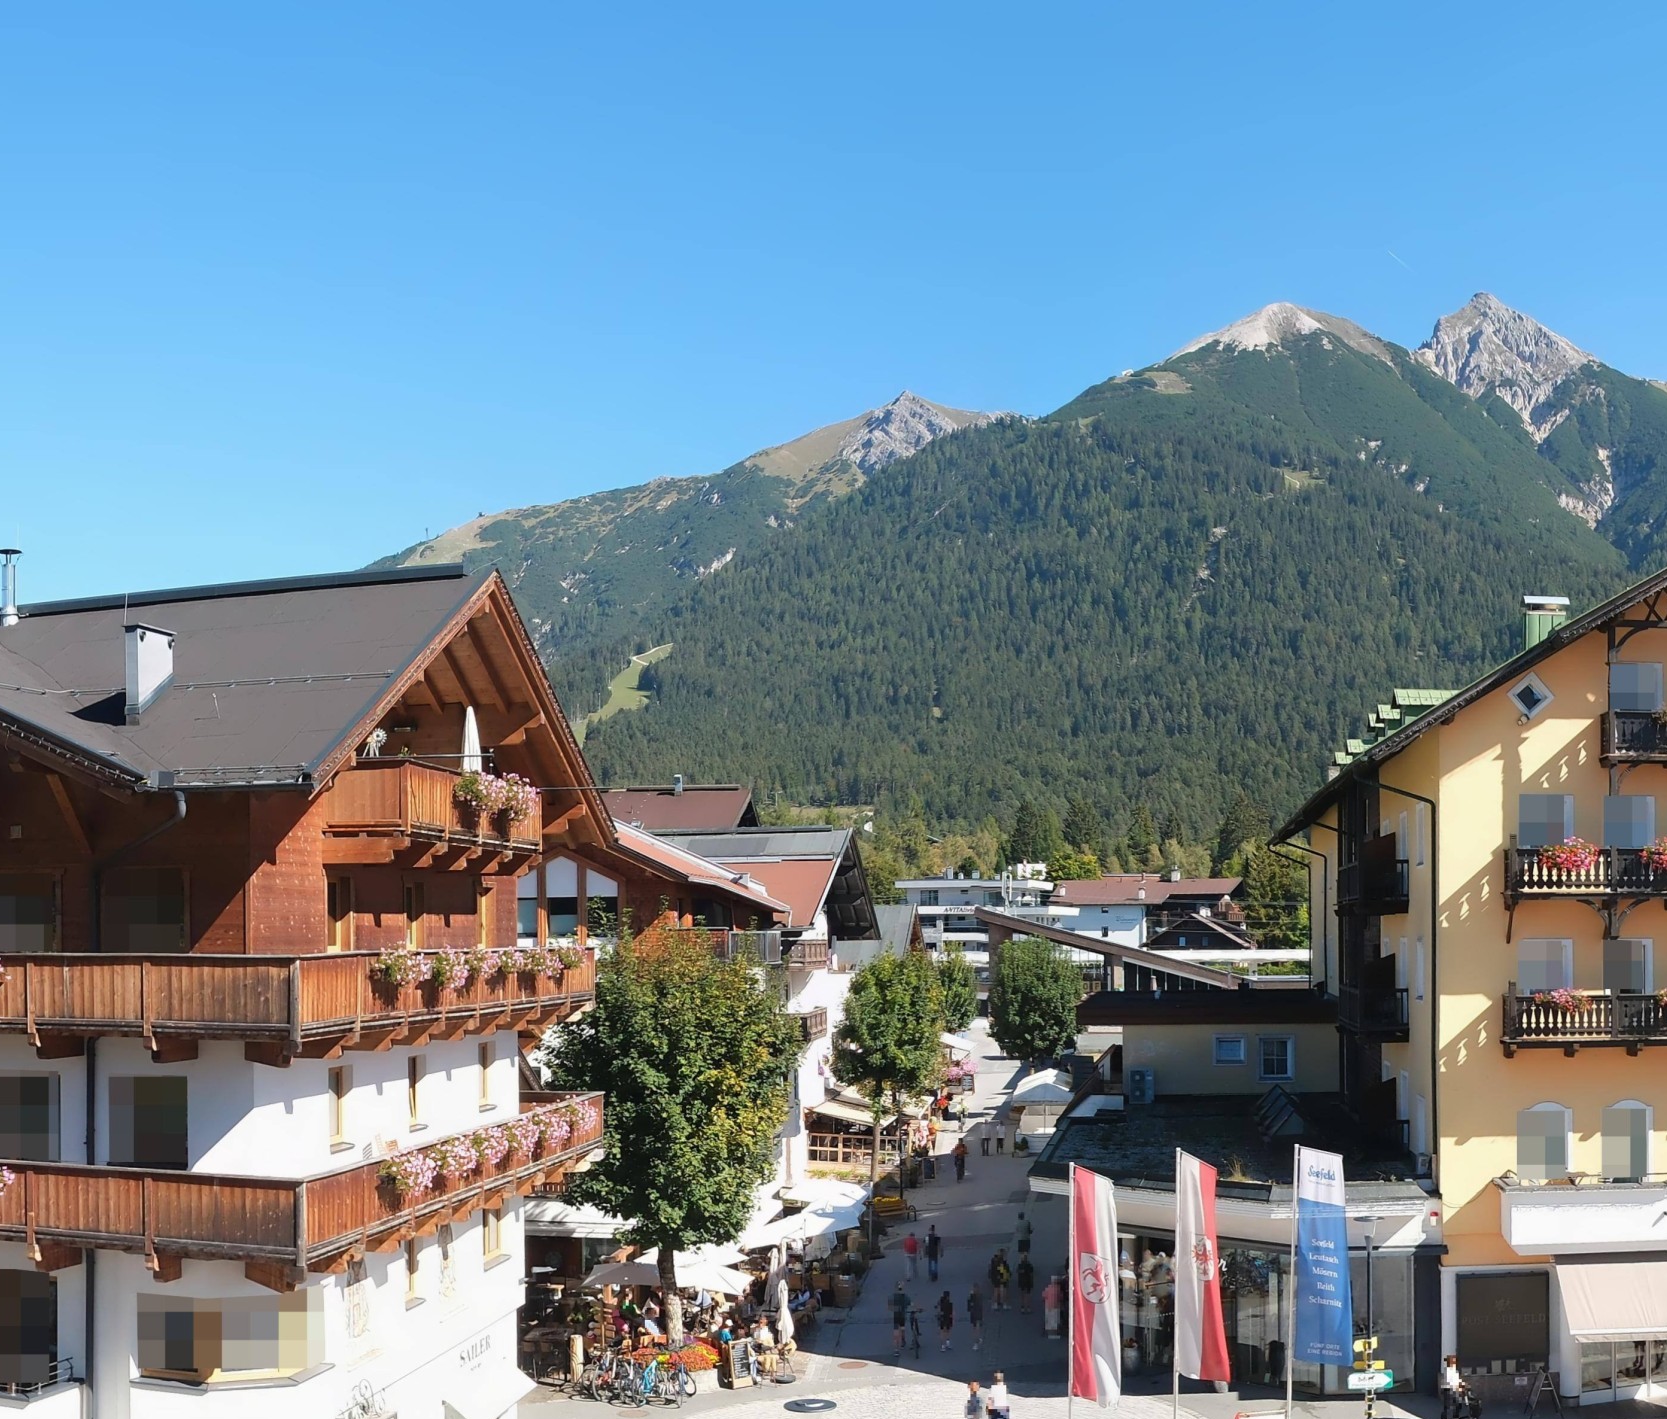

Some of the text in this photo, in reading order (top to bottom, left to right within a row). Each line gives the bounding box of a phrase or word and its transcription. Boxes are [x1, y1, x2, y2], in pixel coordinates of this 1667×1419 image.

[1308, 1165, 1336, 1181] Seefeld
[1311, 1238, 1335, 1249] Seefeld
[1309, 1252, 1339, 1265] Leutasch
[1312, 1266, 1338, 1279] Mösern
[1317, 1281, 1335, 1292] Reith
[1309, 1295, 1342, 1308] Scharnitz
[459, 1334, 491, 1367] SAILER
